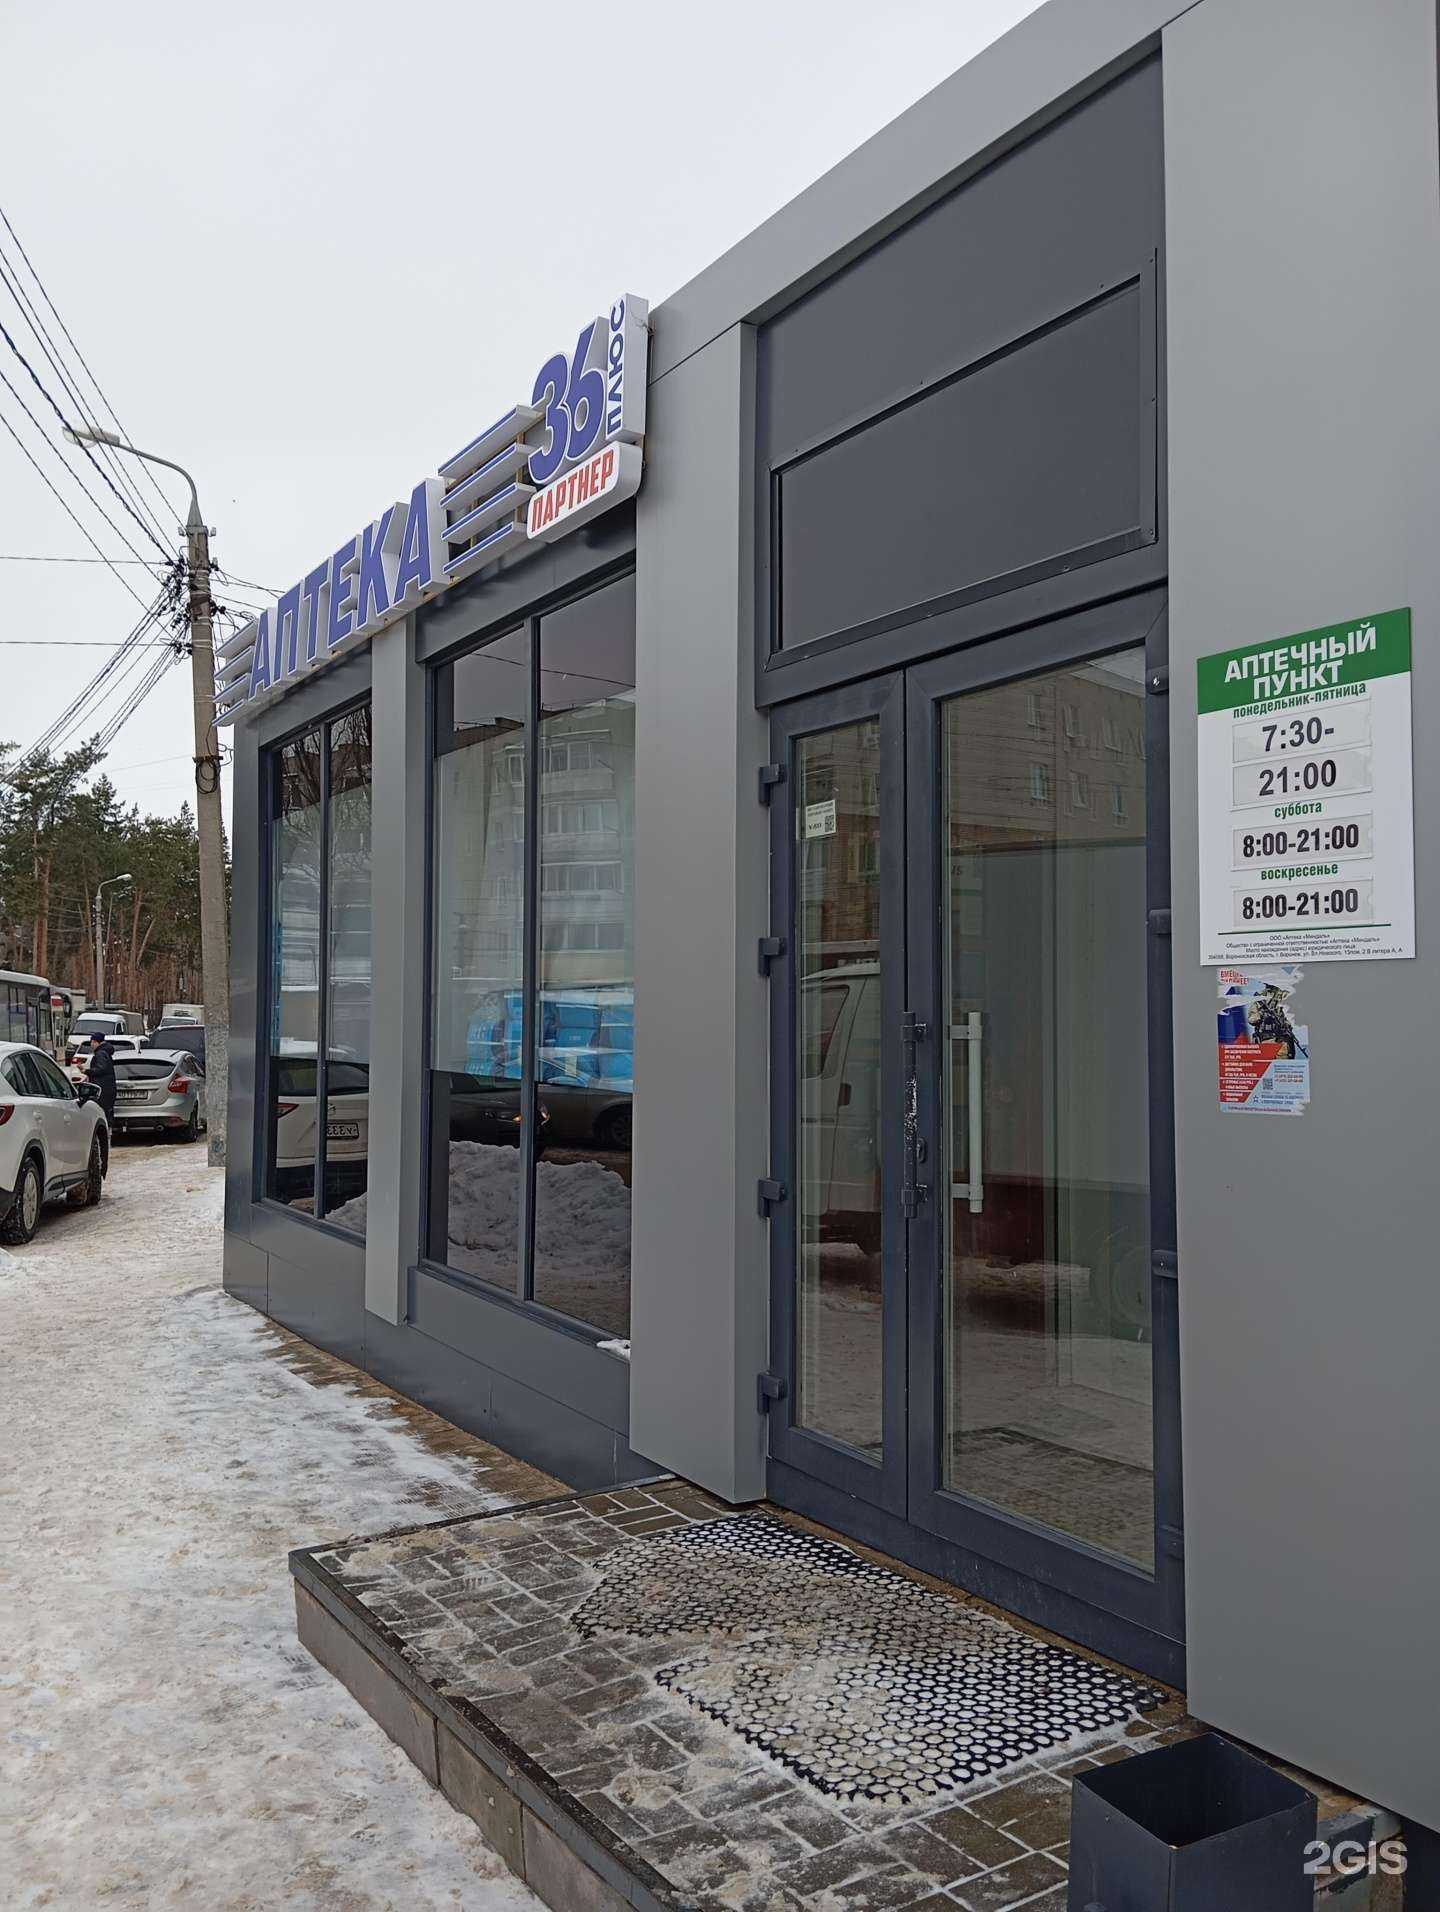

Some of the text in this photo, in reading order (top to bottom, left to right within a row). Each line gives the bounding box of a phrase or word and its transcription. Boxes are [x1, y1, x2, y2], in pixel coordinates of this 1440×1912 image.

[607, 299, 625, 436] ПЛЮС
[528, 320, 606, 485] 36
[531, 449, 615, 533] ПАРТНЕР
[249, 480, 433, 701] АПТЕКА
[1224, 622, 1377, 683] АПТЕЧНЫЙ
[1253, 659, 1344, 700] ПУНКТ
[1233, 682, 1367, 719] понедельник-пятница
[1262, 716, 1335, 752] 7:30-
[1258, 759, 1337, 796] 21:00
[1274, 801, 1323, 820] суббота
[1242, 823, 1359, 858] 8:00-21:00
[1260, 863, 1339, 881] воскресенье
[1242, 888, 1359, 920] 8:00-21:00
